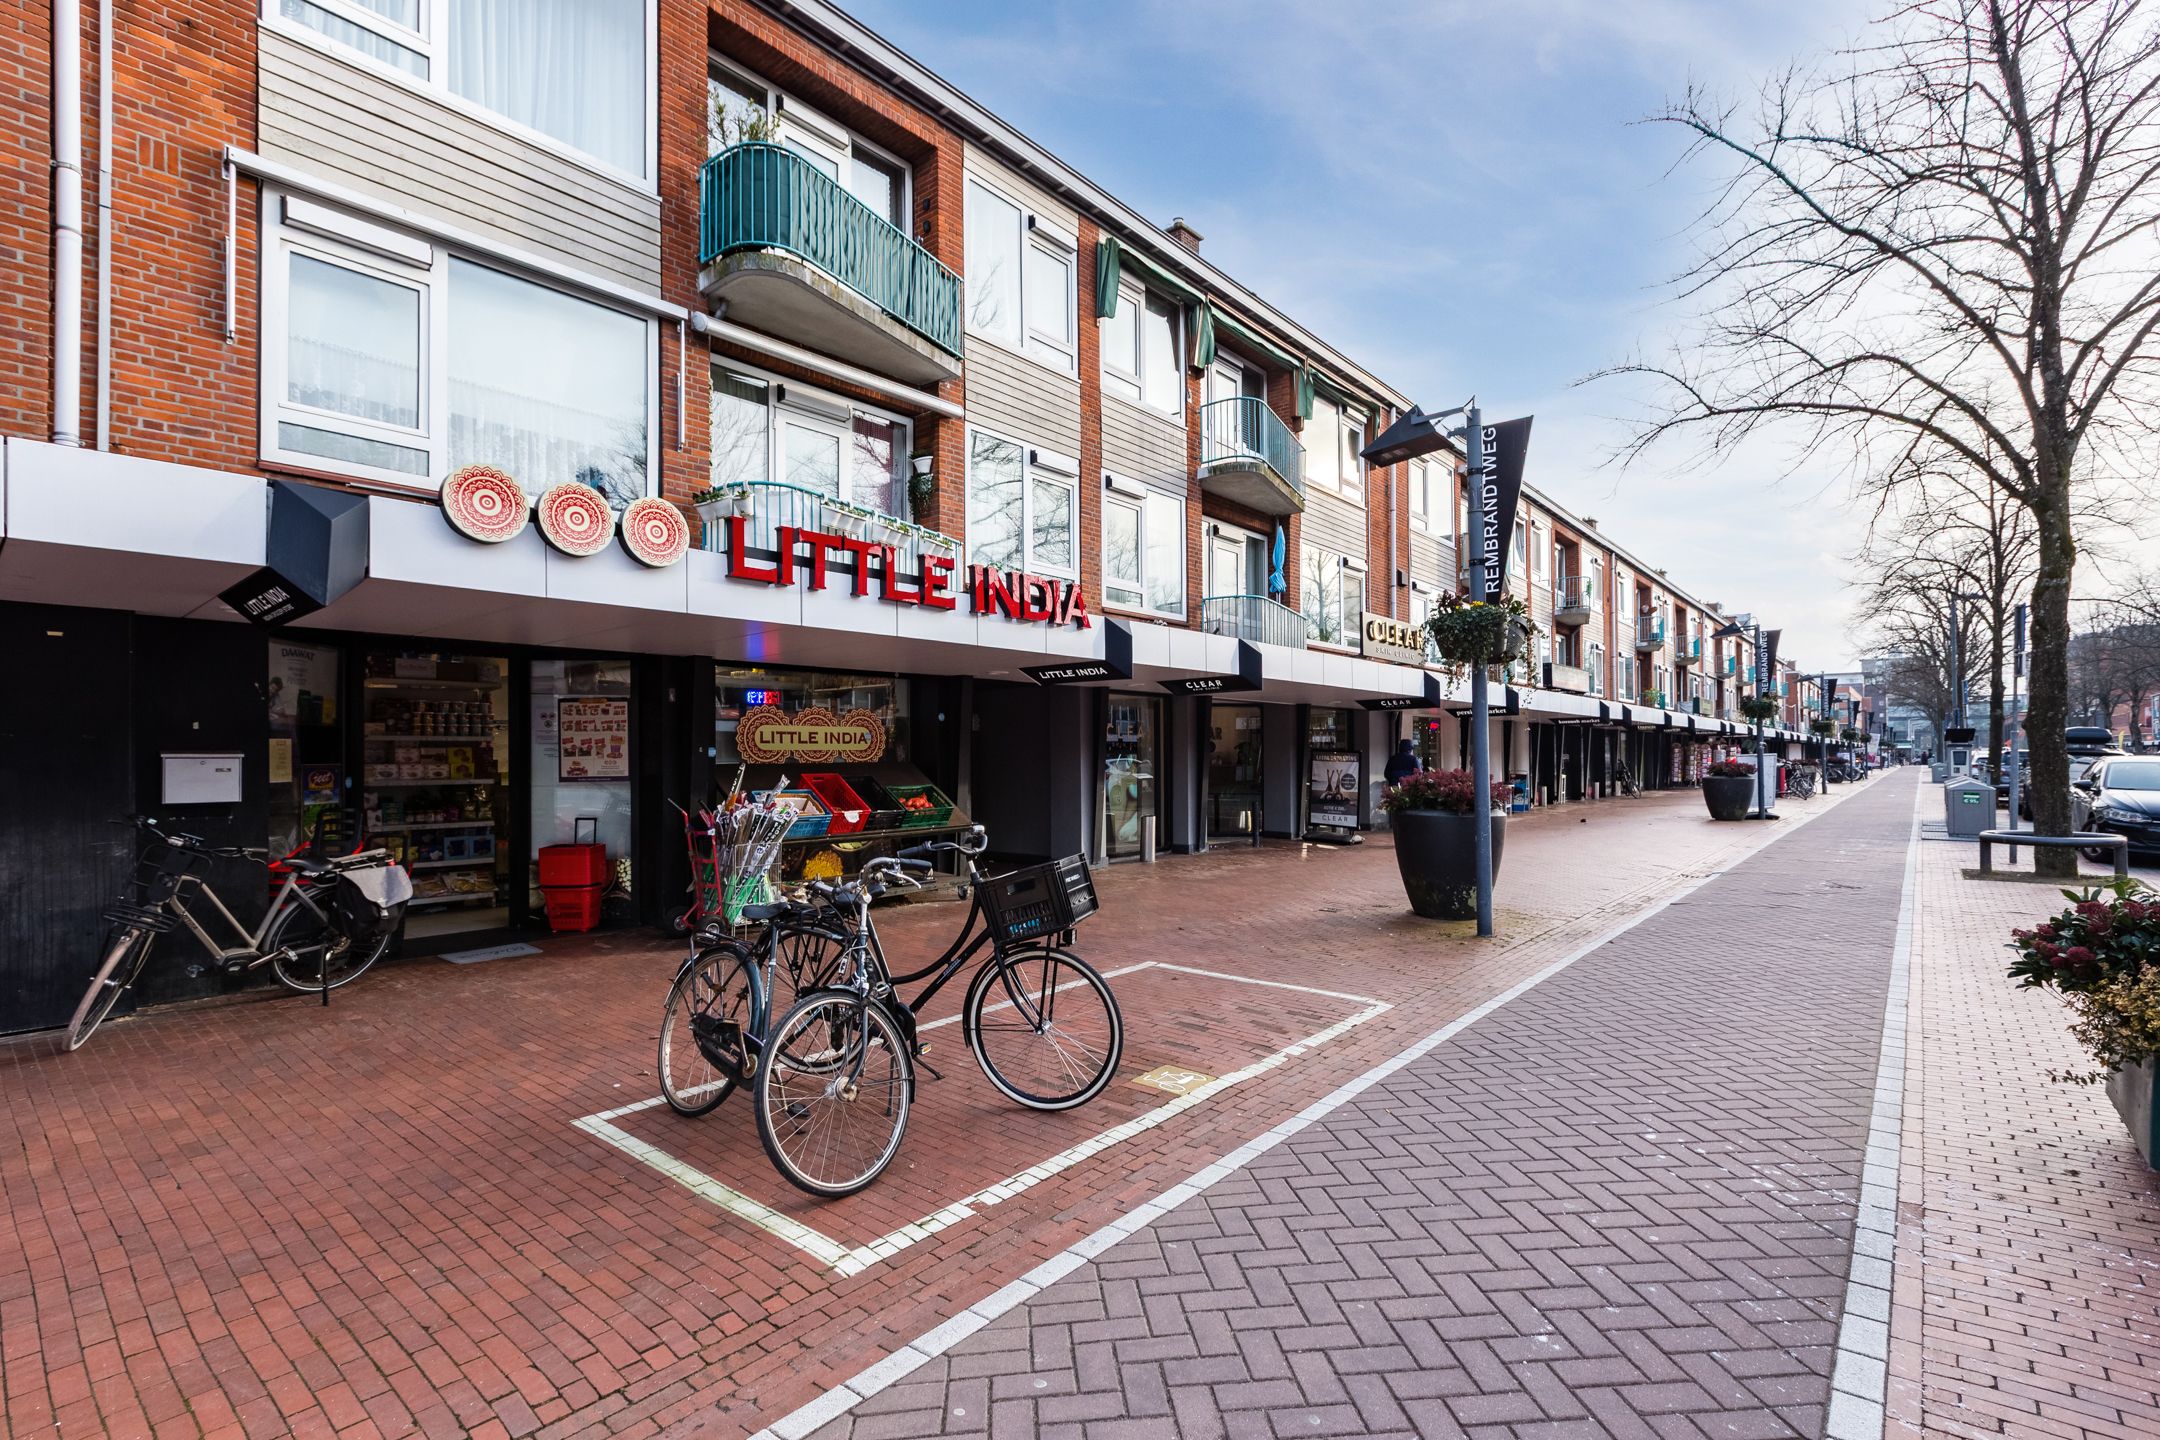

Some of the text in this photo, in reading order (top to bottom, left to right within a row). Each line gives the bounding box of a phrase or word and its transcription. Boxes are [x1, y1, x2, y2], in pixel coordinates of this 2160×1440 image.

[1482, 427, 1499, 593] REMBRANDTWEG
[726, 515, 1092, 630] LITTLE INDIA
[1760, 631, 1769, 693] REMBRANDTWEG
[1038, 666, 1108, 679] LITTLE INDIA
[1185, 679, 1223, 689] CLEAR
[1380, 699, 1411, 707] CLEAR
[759, 731, 868, 744] LITTLE INDIA
[1322, 814, 1348, 822] CLEAR
